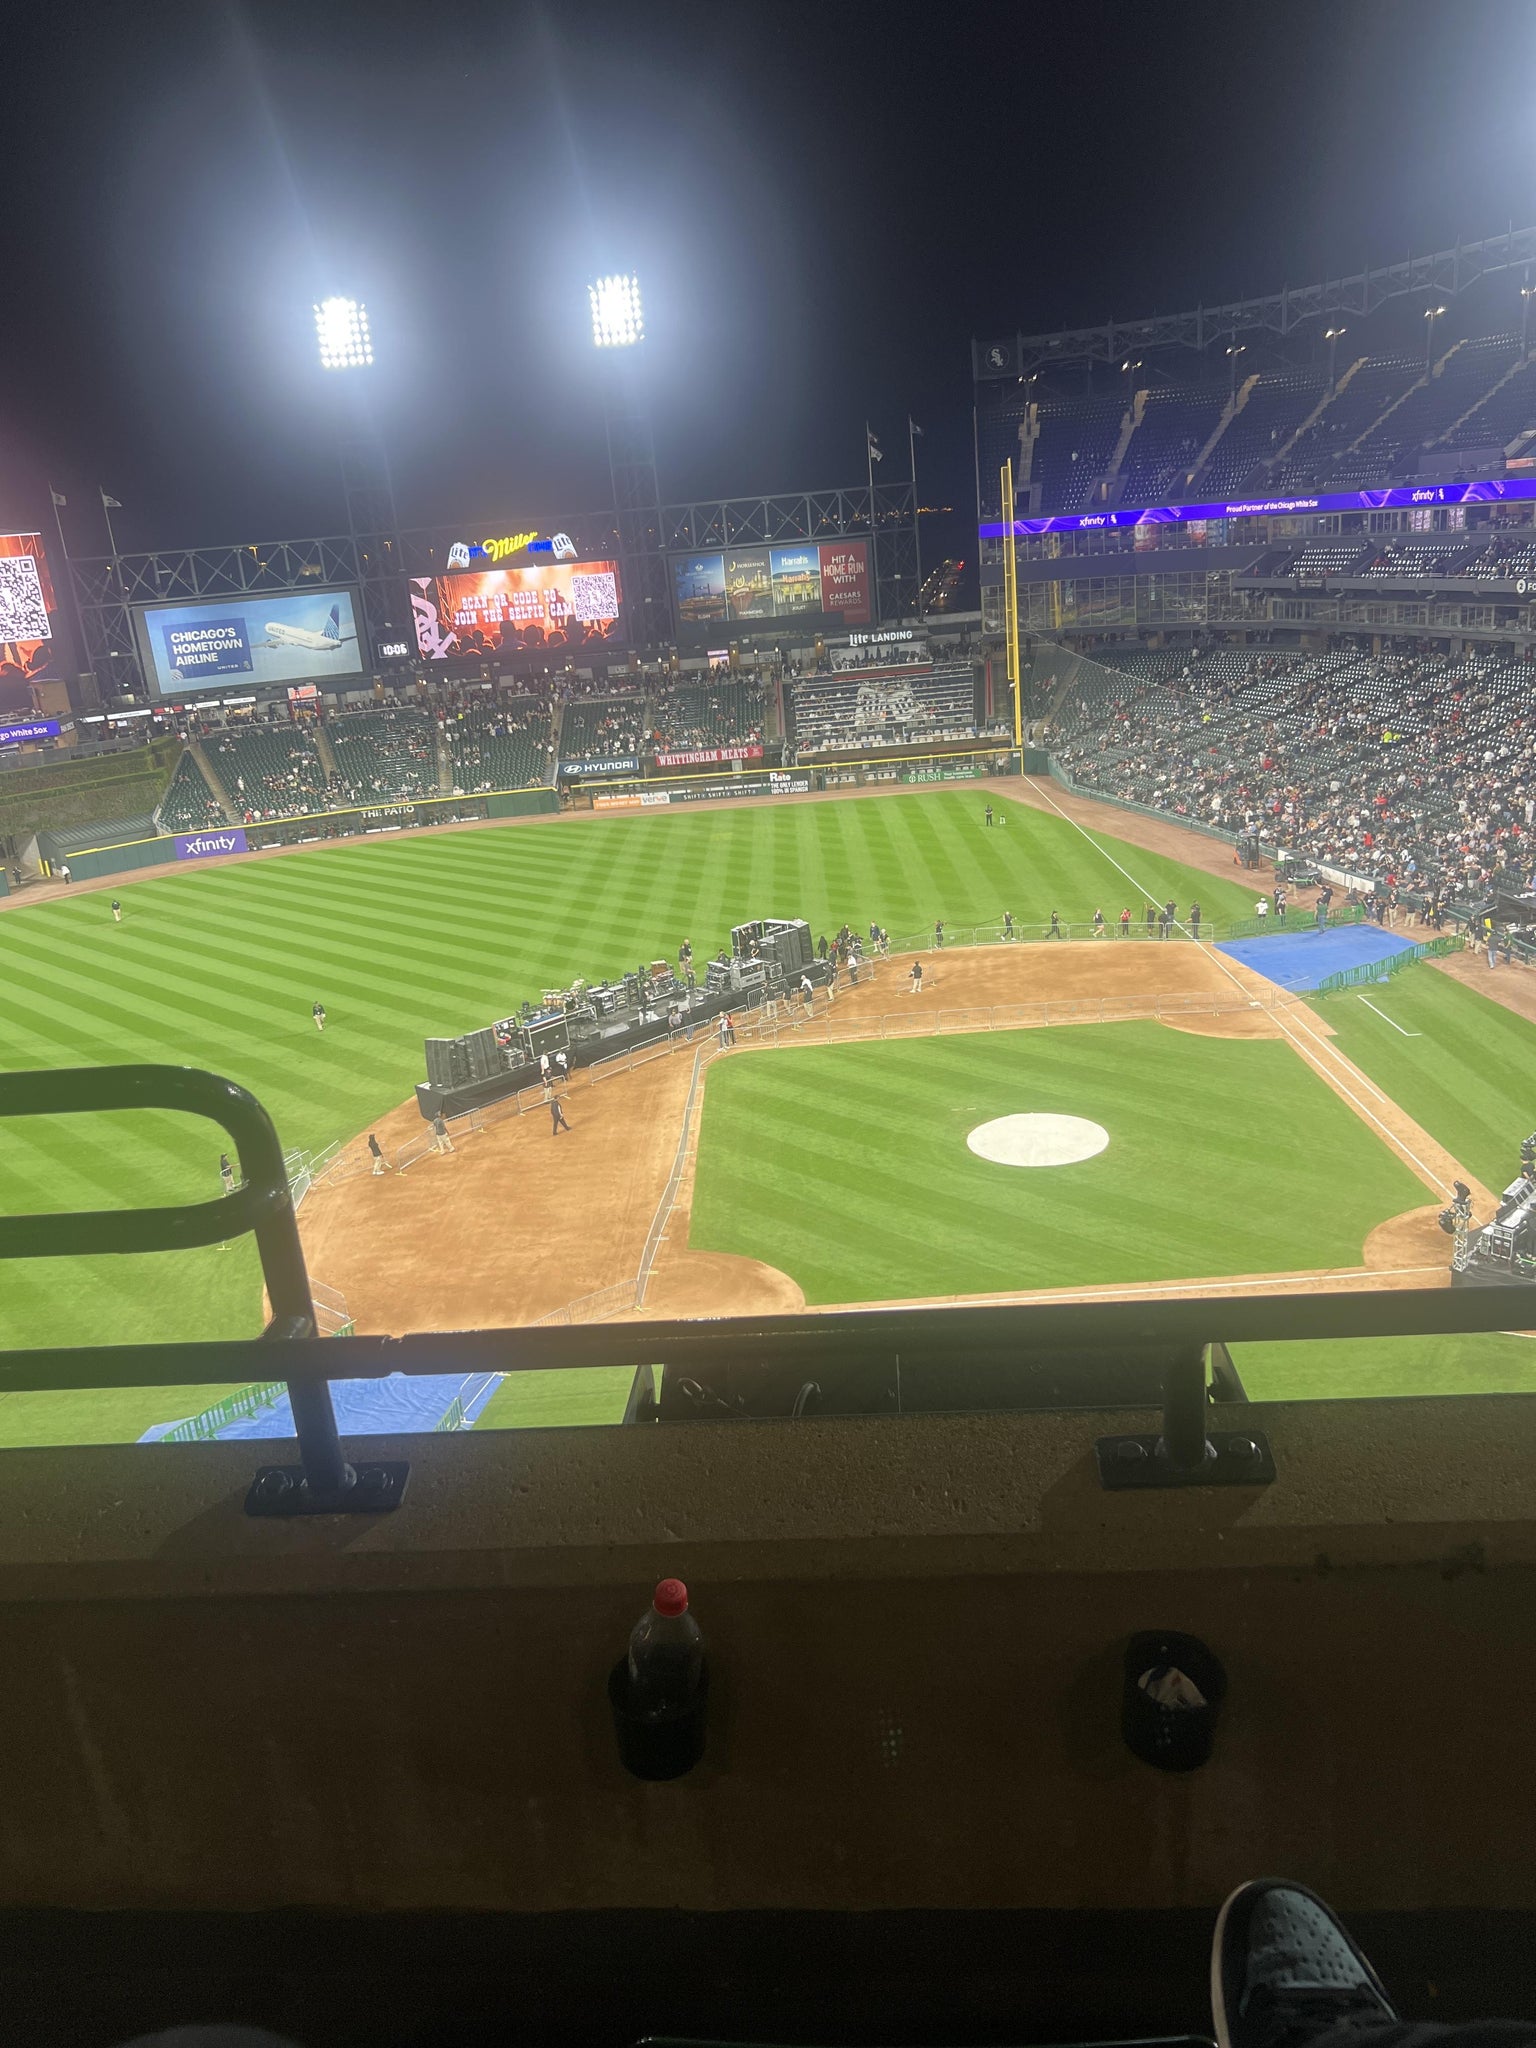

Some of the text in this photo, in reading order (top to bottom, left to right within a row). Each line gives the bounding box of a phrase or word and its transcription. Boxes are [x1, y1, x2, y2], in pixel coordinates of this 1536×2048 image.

[1243, 504, 1263, 512] Partner
[482, 532, 538, 561] Miller
[831, 553, 855, 564] HIT A
[823, 562, 865, 576] HOME RUN
[833, 575, 856, 584] WITH
[462, 589, 557, 610] SCAN QR CODE TO
[829, 591, 861, 600] CAESARS
[454, 602, 573, 626] JOIN THE SELFIE CAM
[170, 627, 237, 643] CHICAGO'S
[849, 630, 913, 647] Lite LANDING
[172, 639, 243, 655] HOMETOWN
[176, 652, 219, 667] AIRLINE
[10, 729, 33, 738] White
[33, 726, 48, 735] Sox
[658, 750, 718, 765] WHITTINGHAM
[721, 748, 749, 760] MEATS
[584, 760, 634, 772] HYUNDAI
[917, 773, 941, 782] RUSH
[384, 805, 415, 816] PATIO
[185, 836, 236, 855] xfinity
